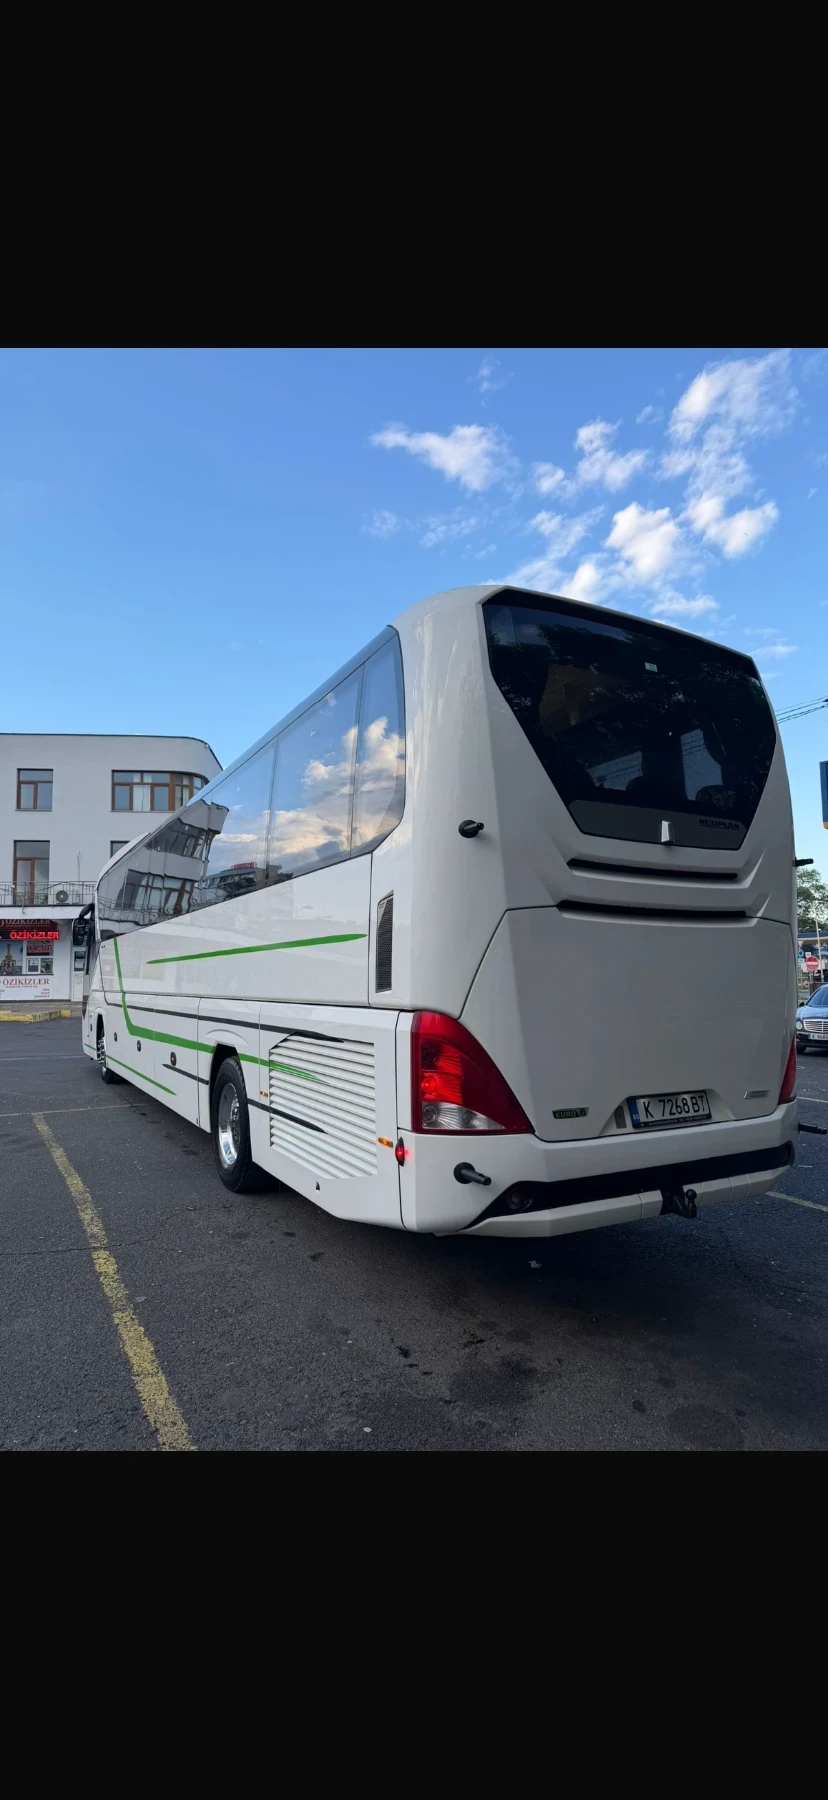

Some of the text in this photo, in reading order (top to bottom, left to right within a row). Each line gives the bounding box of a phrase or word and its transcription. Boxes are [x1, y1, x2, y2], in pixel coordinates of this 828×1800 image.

[10, 930, 59, 939] ÖZİKİZLER
[3, 977, 50, 985] ÖZİKİZLER
[643, 1095, 704, 1118] K 7268 BT
[556, 1110, 577, 1119] EURO
